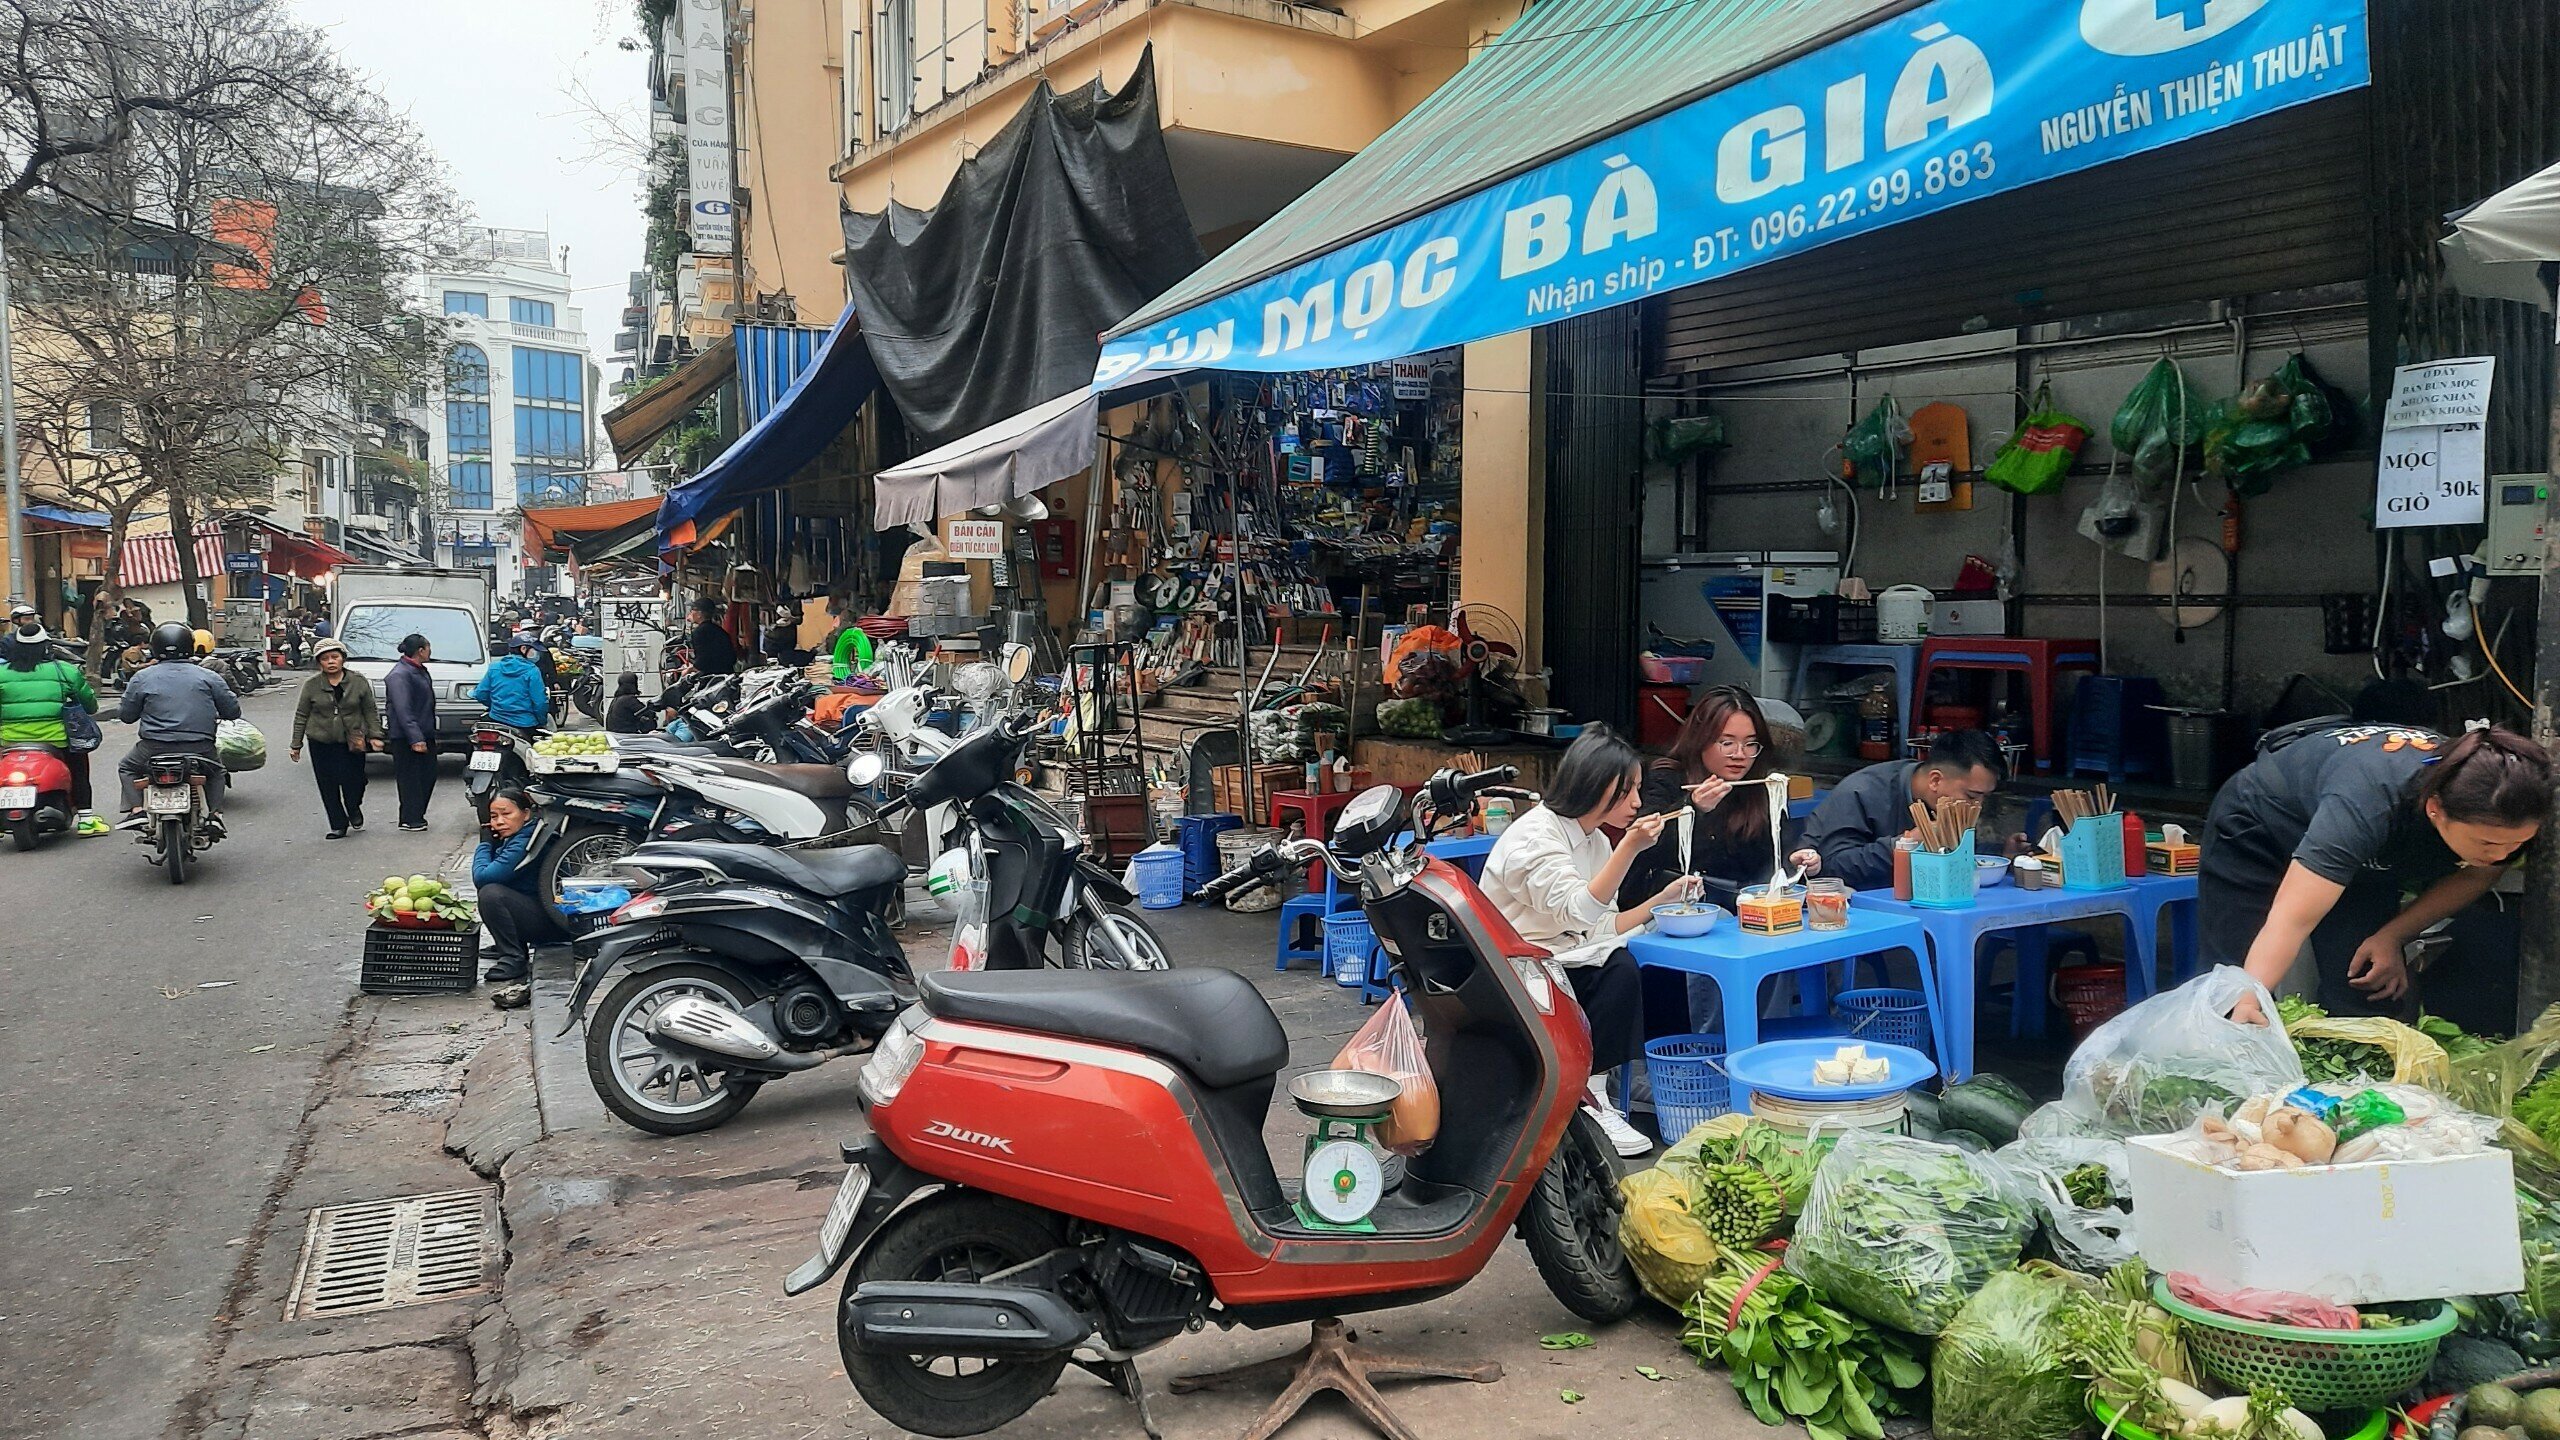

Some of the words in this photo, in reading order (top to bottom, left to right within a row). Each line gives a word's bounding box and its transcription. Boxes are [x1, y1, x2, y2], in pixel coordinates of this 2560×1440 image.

[2041, 83, 2153, 155] NGUYỄN
[2159, 58, 2244, 115] THIỆN
[2252, 24, 2347, 90] THUẬT
[1095, 318, 1235, 383] BÚN
[1257, 236, 1460, 358] MỌC
[1500, 154, 1659, 280] BÀ
[1716, 21, 1995, 205] GIÀ
[1527, 278, 1595, 316] Nhận
[1604, 257, 1665, 292] ship
[1692, 229, 1741, 270] ĐT:
[1751, 141, 1996, 251] 096.22.99.883
[1394, 361, 1428, 378] THÀNH
[2385, 452, 2437, 472] MỌC
[2441, 480, 2481, 498] 30k
[2387, 492, 2430, 513] GIÒ
